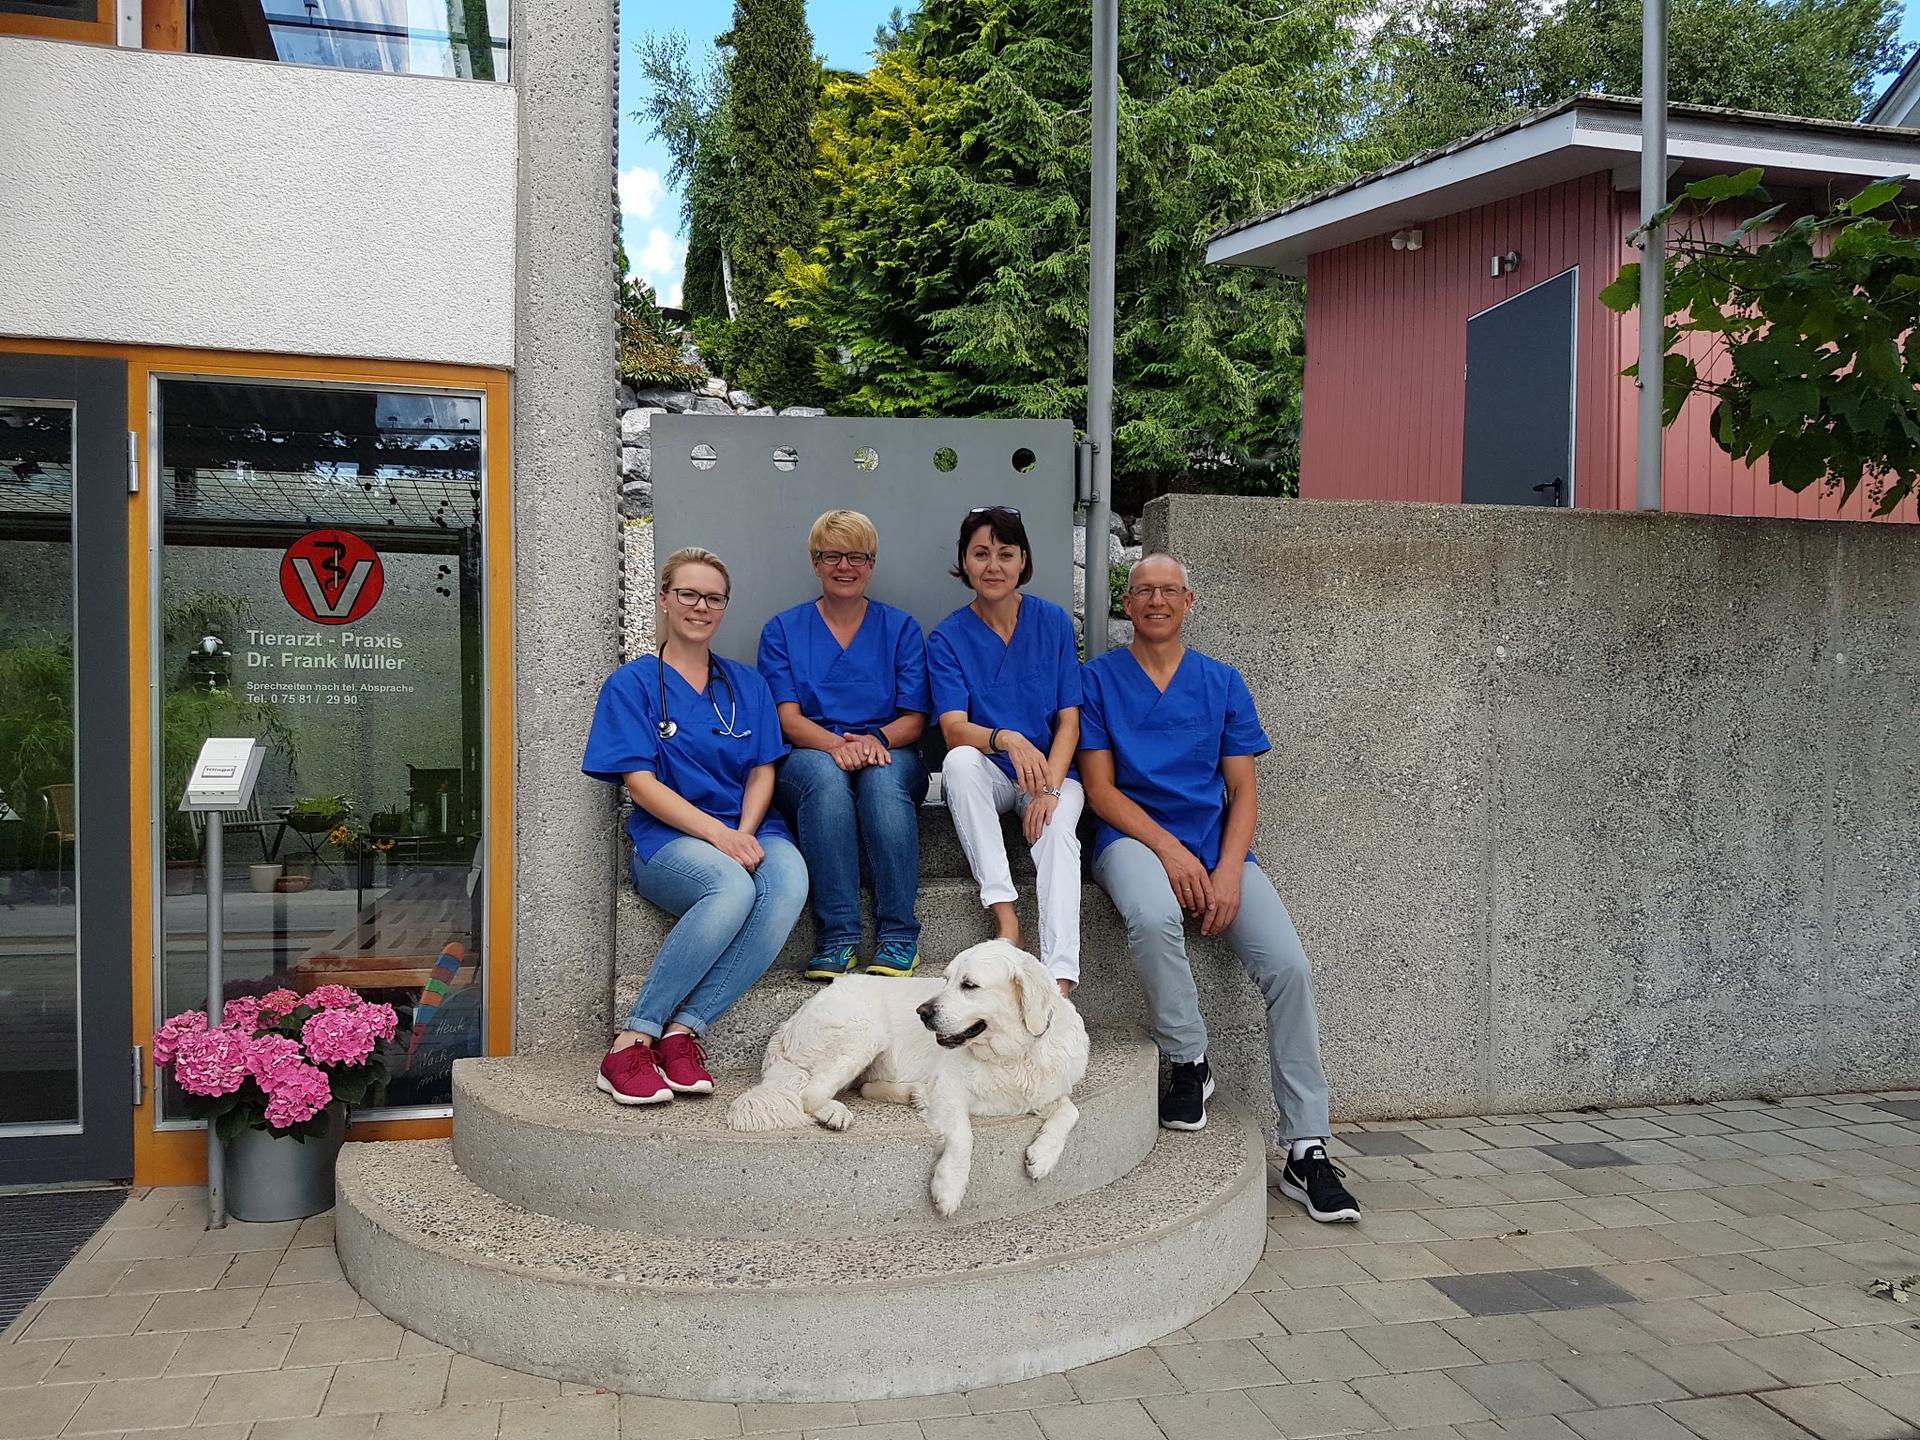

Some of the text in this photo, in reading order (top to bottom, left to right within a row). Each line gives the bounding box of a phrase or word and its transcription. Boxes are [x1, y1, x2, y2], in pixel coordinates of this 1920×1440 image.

[247, 630, 323, 647] Tierarzt
[341, 632, 403, 649] Praxis
[247, 652, 406, 670] Dr. Frank Müller
[246, 681, 414, 693] Sprechzeiten nach tel. Absprache
[246, 694, 267, 703] Tel.
[271, 694, 278, 704] 0
[281, 694, 296, 704] 75
[299, 694, 312, 704] 81
[326, 695, 340, 704] 29
[343, 695, 358, 704] 90
